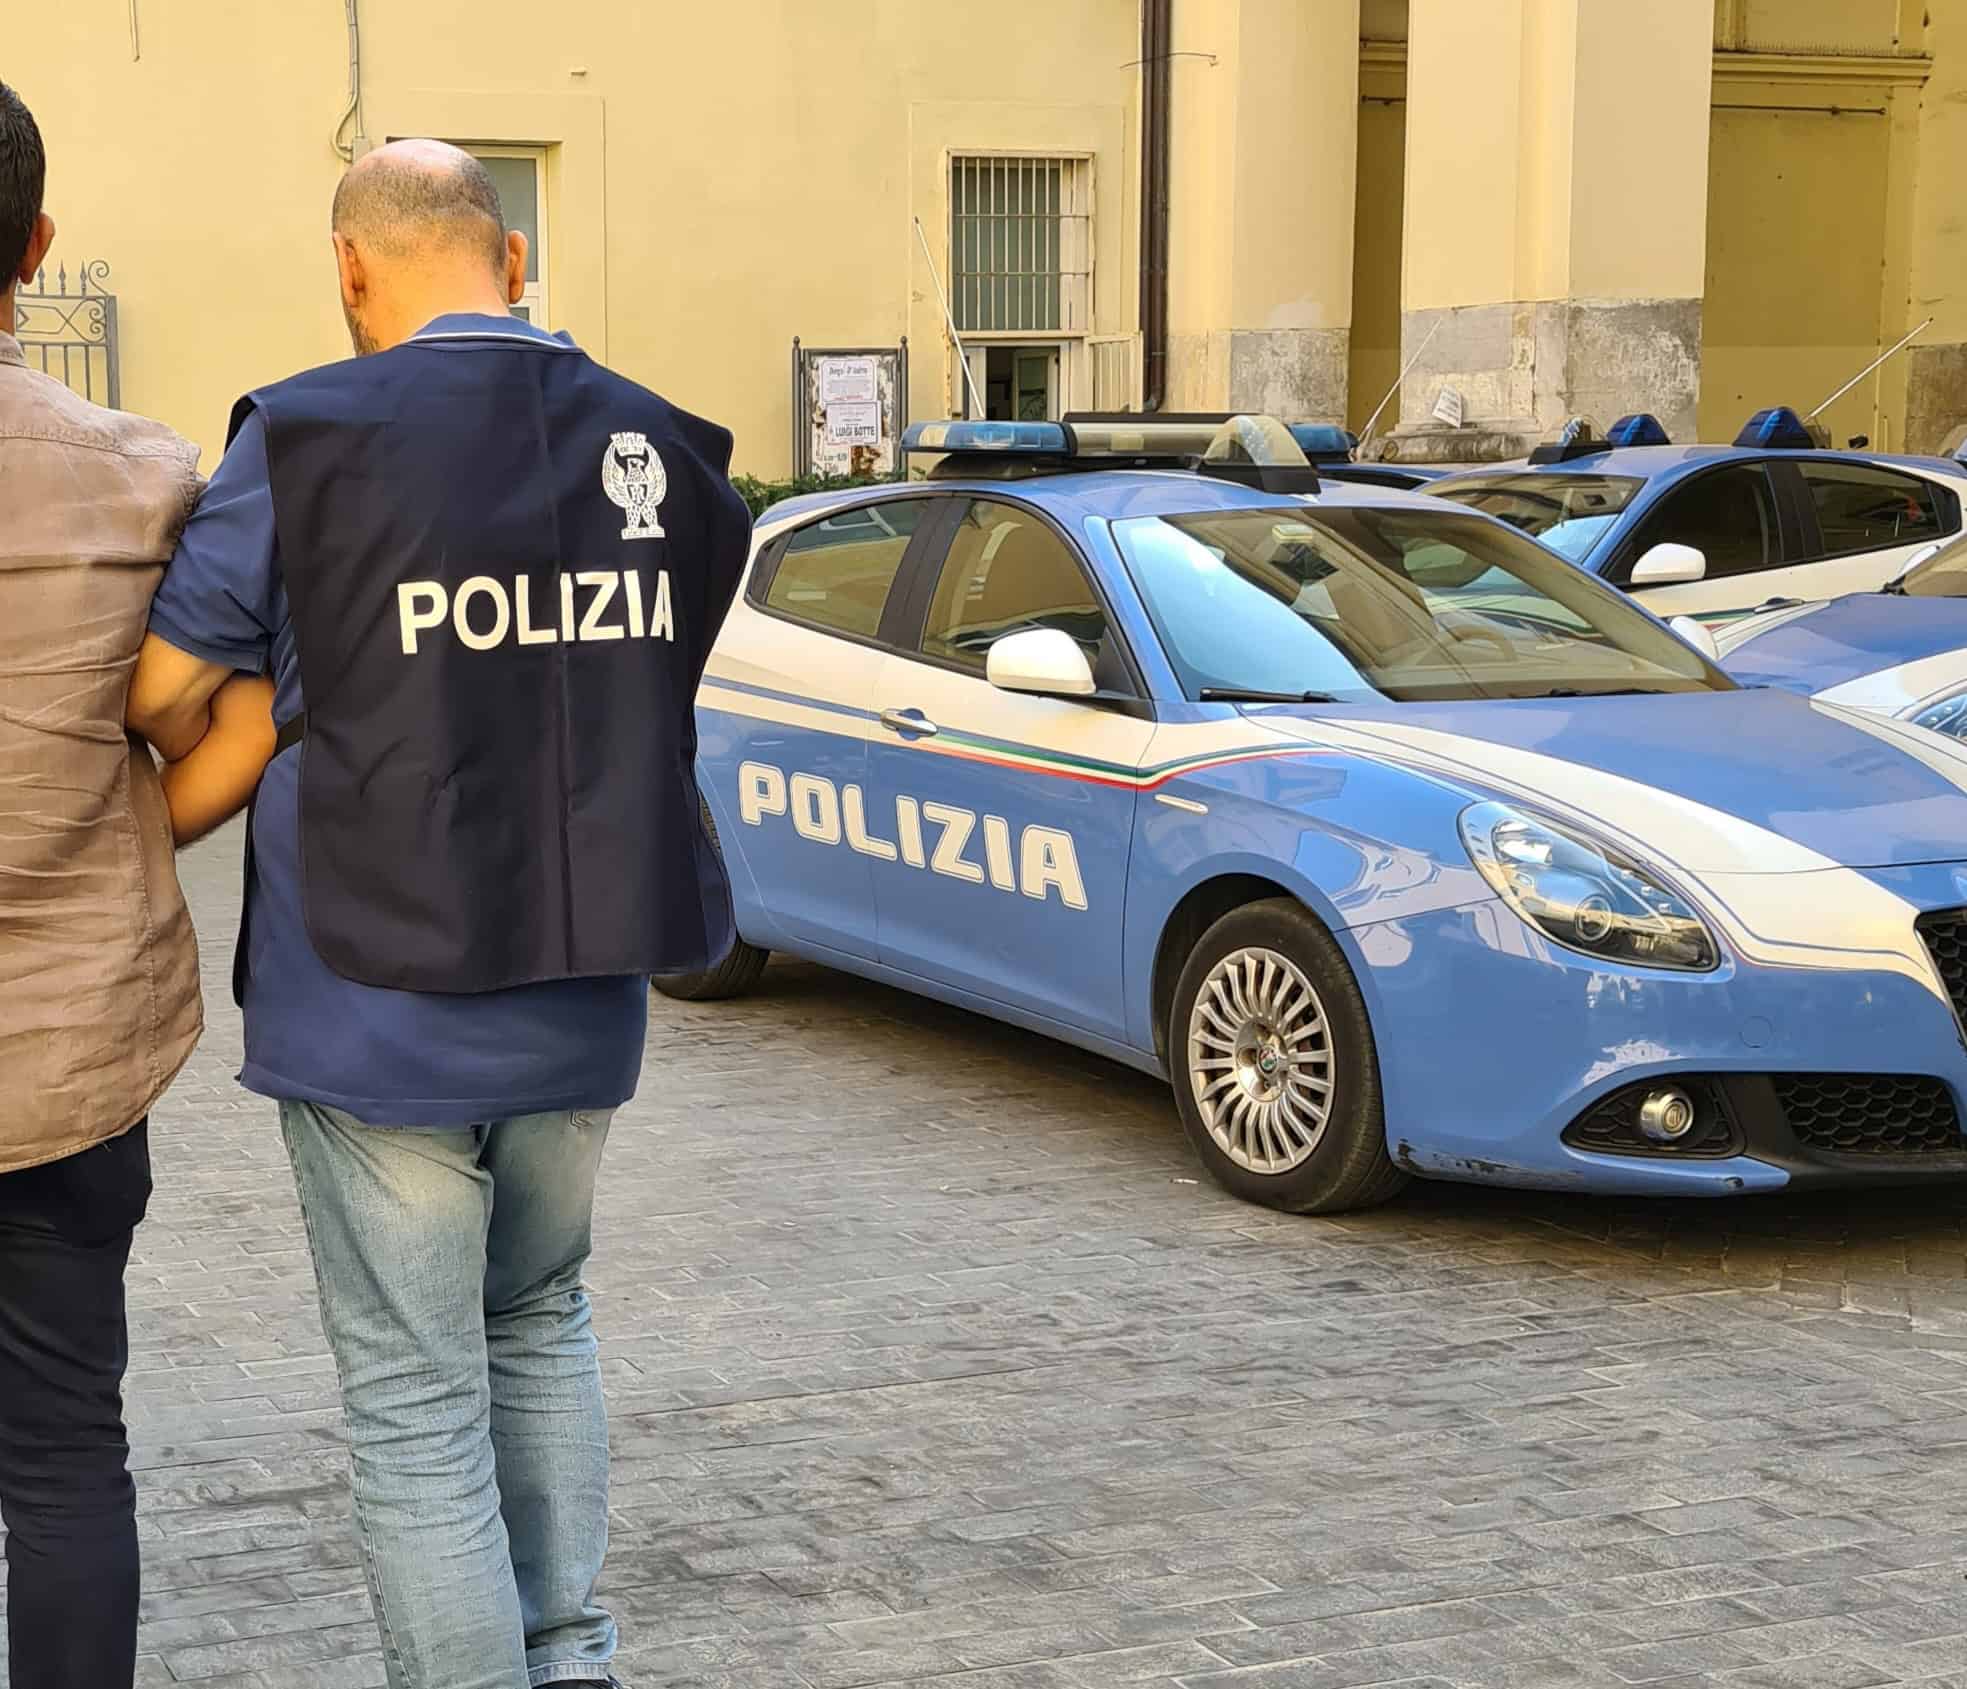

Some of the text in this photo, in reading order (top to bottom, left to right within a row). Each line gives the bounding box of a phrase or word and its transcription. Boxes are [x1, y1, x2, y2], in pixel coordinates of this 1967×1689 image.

[835, 426, 852, 437] LUIGI
[397, 569, 674, 655] POLIZIA
[738, 760, 1089, 911] POLIZIA
